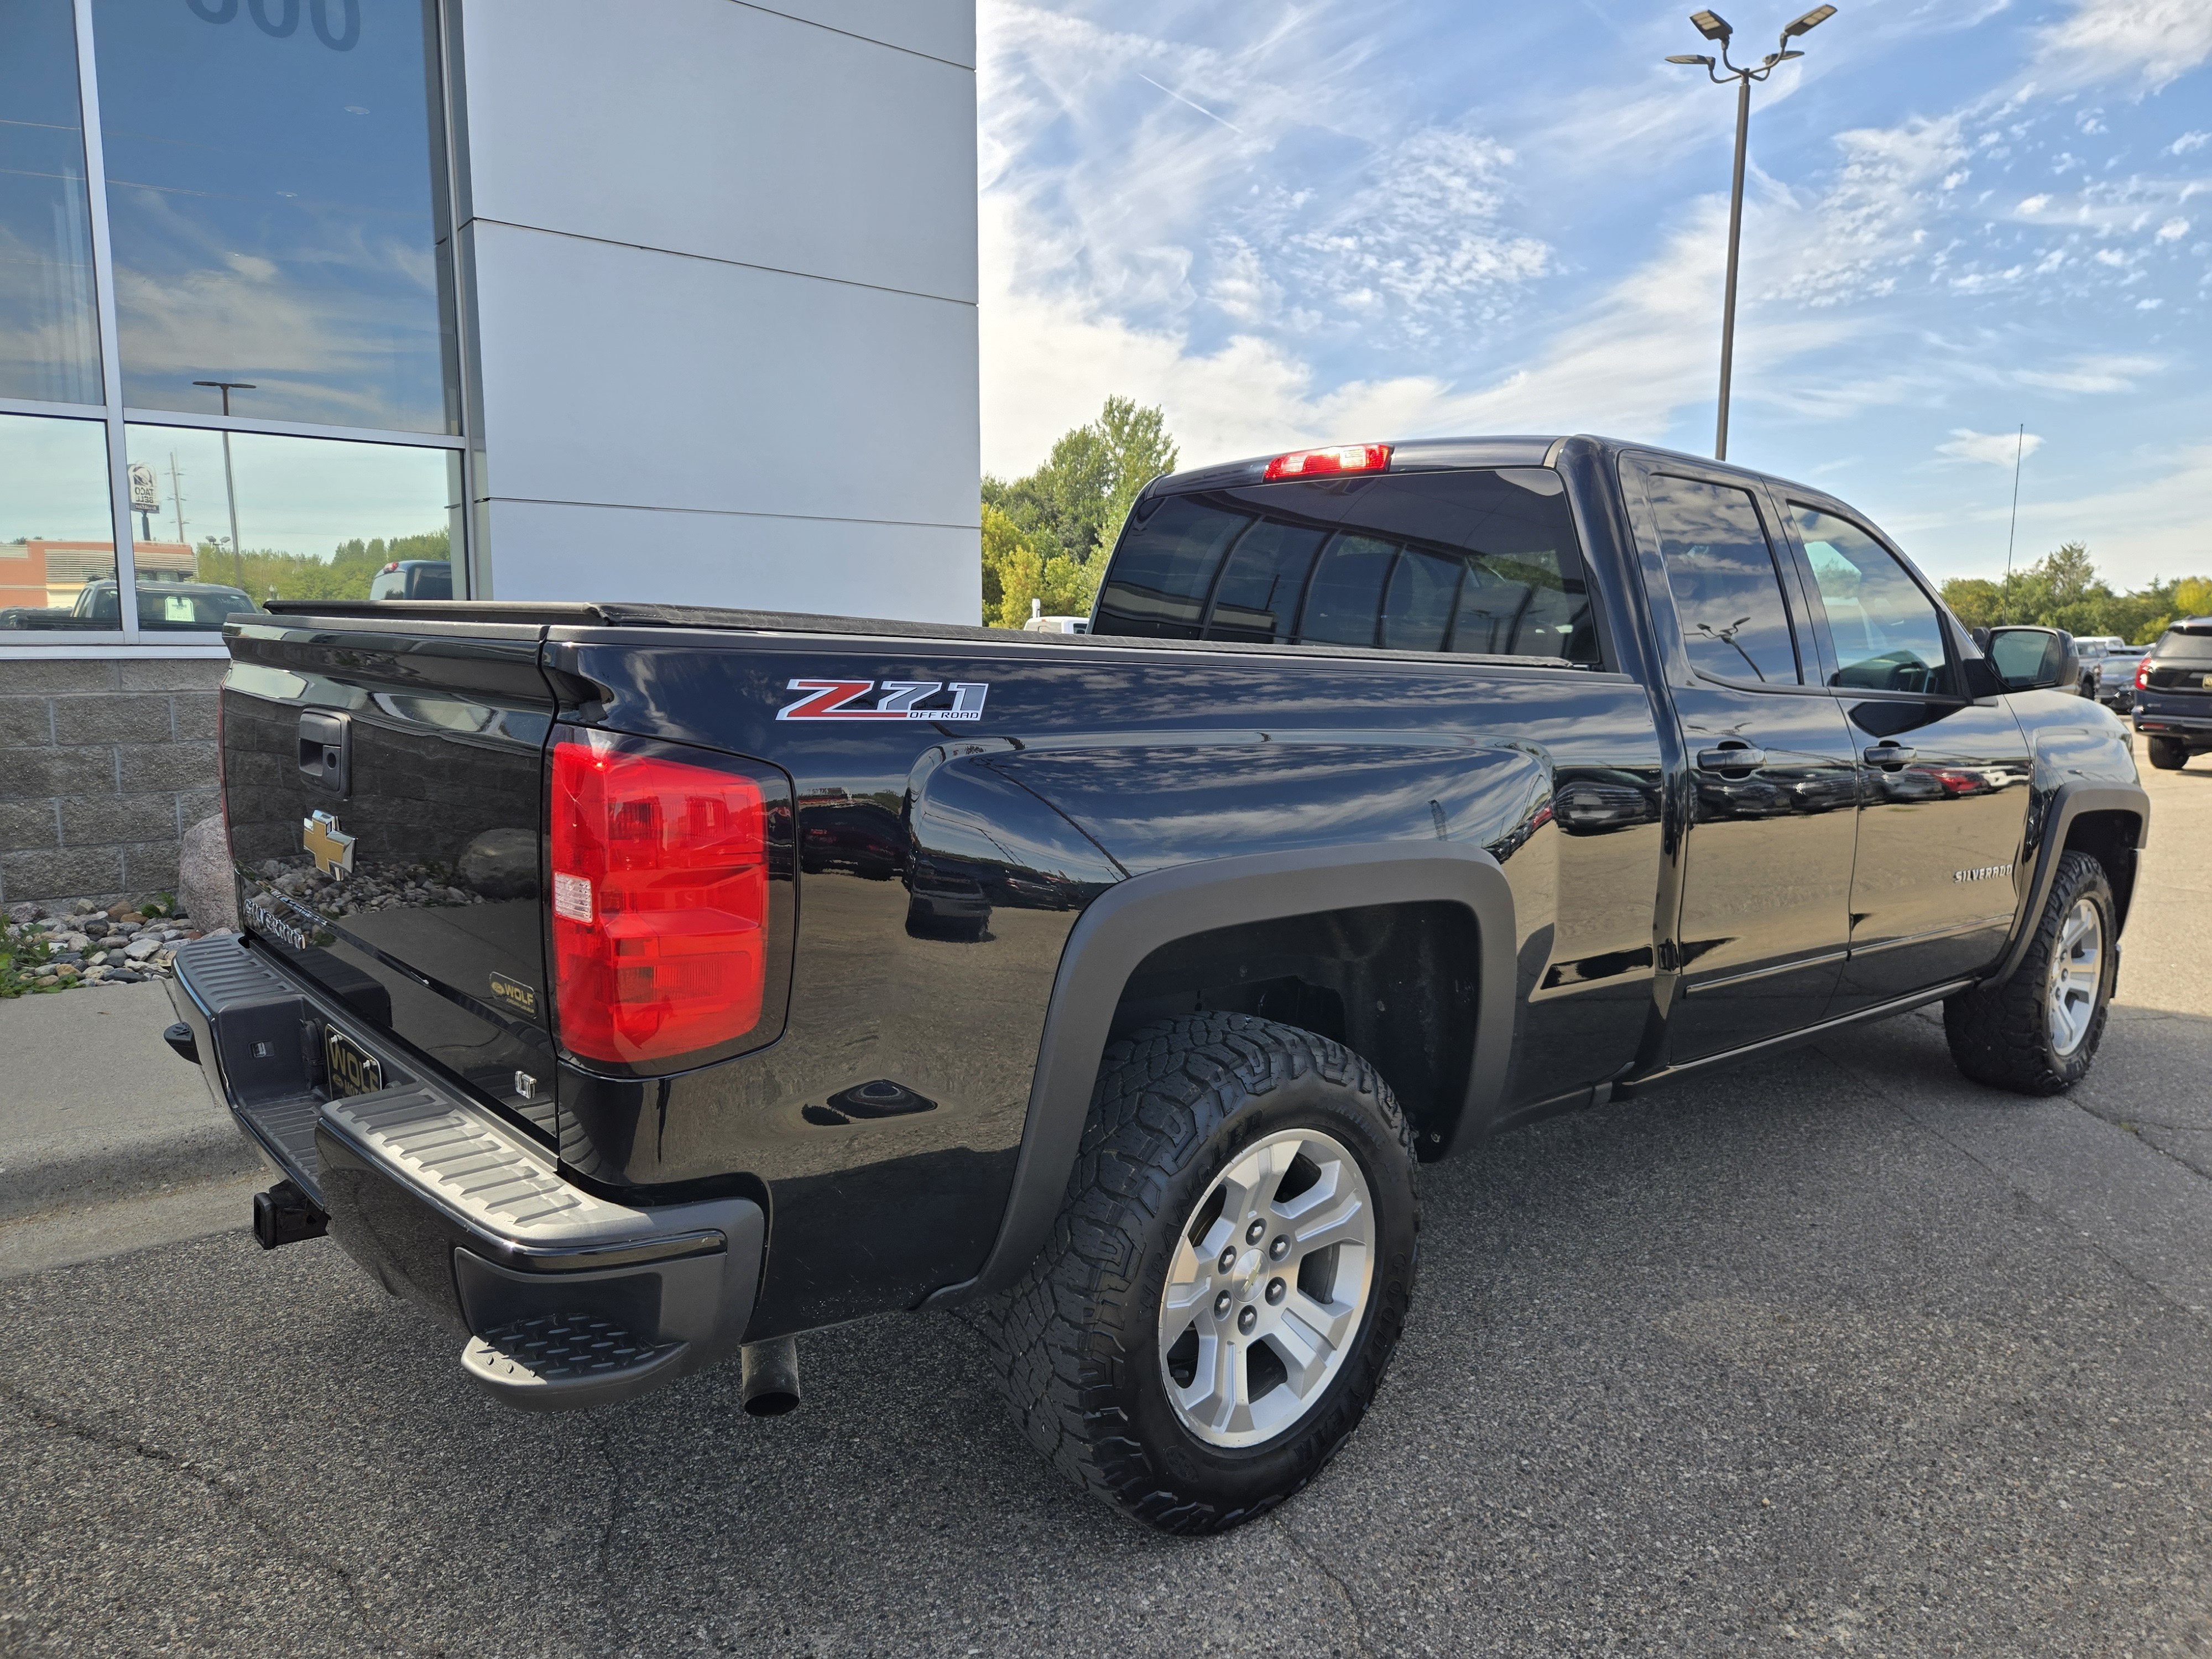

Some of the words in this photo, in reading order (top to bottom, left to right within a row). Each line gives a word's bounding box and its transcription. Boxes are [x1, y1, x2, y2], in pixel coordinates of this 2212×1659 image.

[775, 679, 989, 721] Z71
[1954, 863, 2013, 883] SILVERADO
[504, 983, 534, 1006] WOLF
[328, 1037, 378, 1093] WOLF
